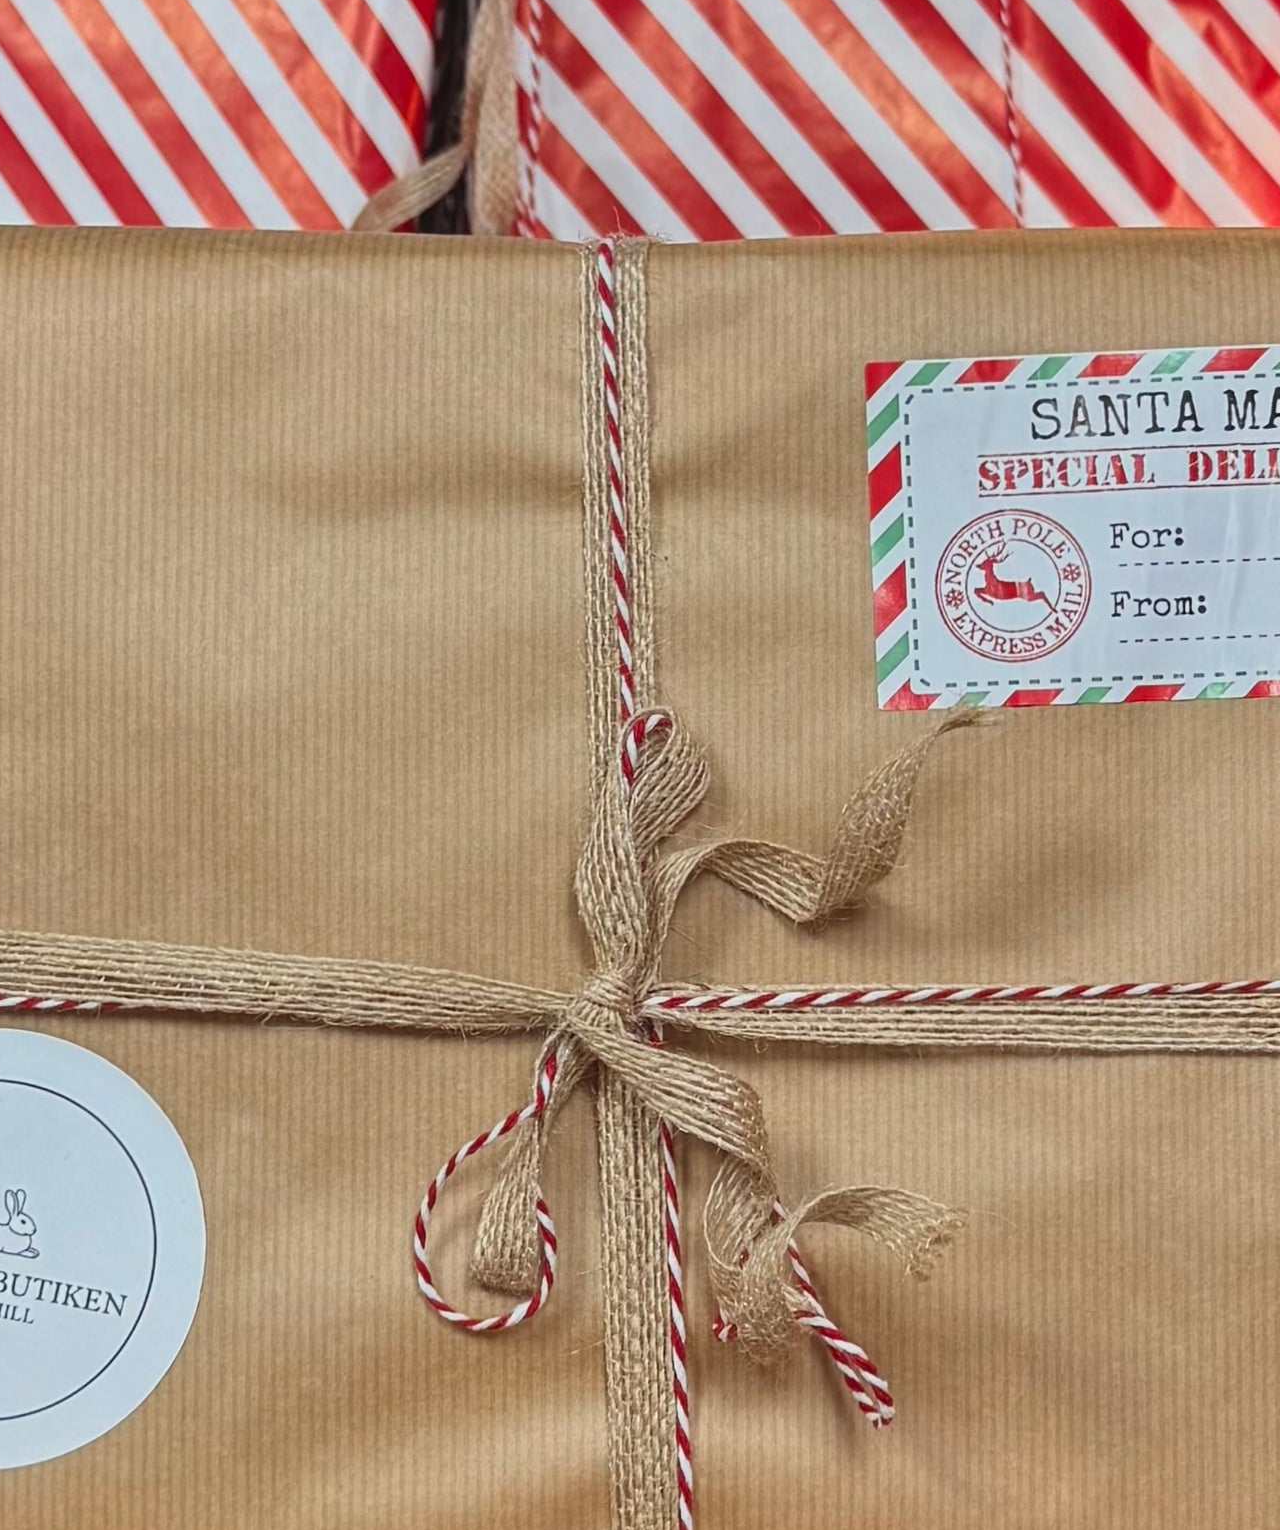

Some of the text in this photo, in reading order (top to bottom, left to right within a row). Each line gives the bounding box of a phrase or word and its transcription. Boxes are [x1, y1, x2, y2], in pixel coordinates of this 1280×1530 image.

[1030, 388, 1204, 440] SANTA
[977, 451, 1157, 493] SPECIAL
[945, 518, 1071, 586] NORTH POLE
[1108, 521, 1185, 550] For:
[952, 583, 1084, 655] EXPRESS MAIL
[1108, 589, 1208, 619] From:
